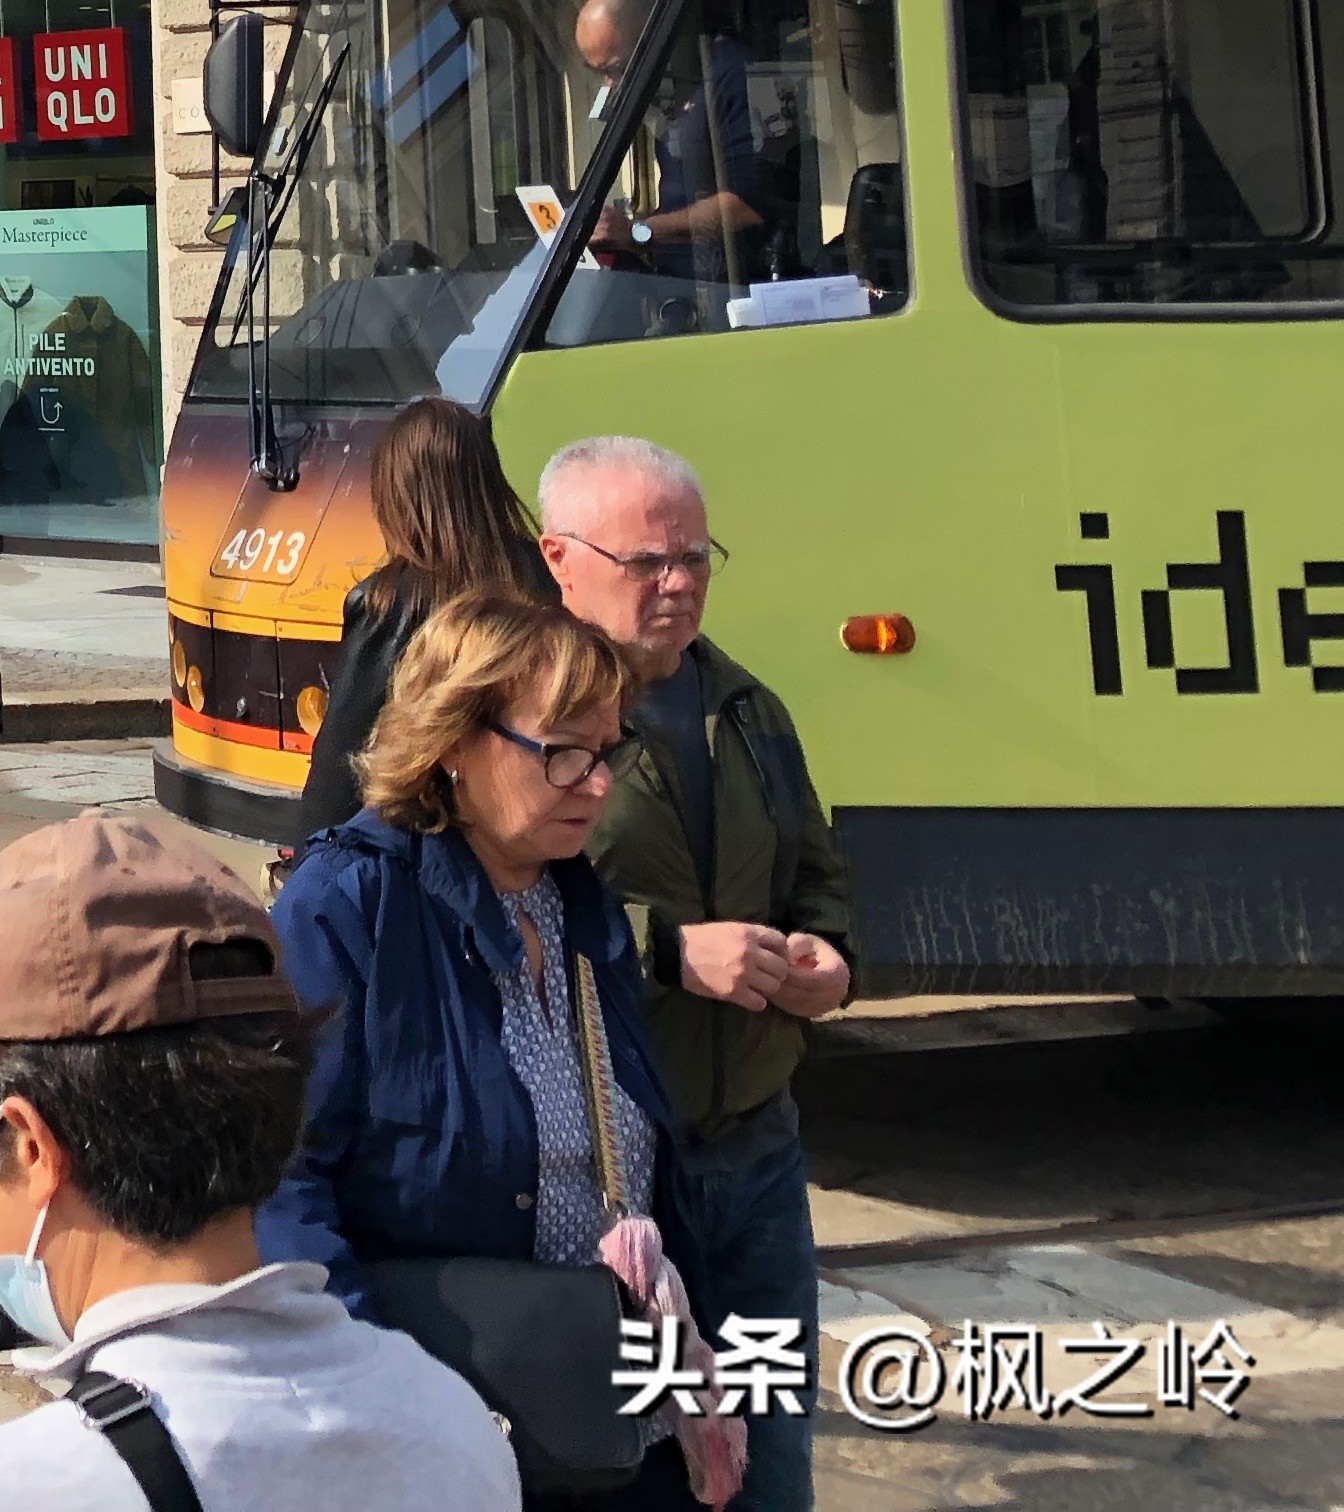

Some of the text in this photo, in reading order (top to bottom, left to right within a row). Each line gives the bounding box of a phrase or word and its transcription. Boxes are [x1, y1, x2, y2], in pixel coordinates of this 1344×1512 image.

[44, 43, 107, 82] UNI
[47, 87, 116, 133] QLO
[2, 226, 88, 248] Masterpiece
[28, 332, 66, 351] PILE
[3, 357, 95, 376] ANTIVENTO
[220, 528, 306, 575] 4913
